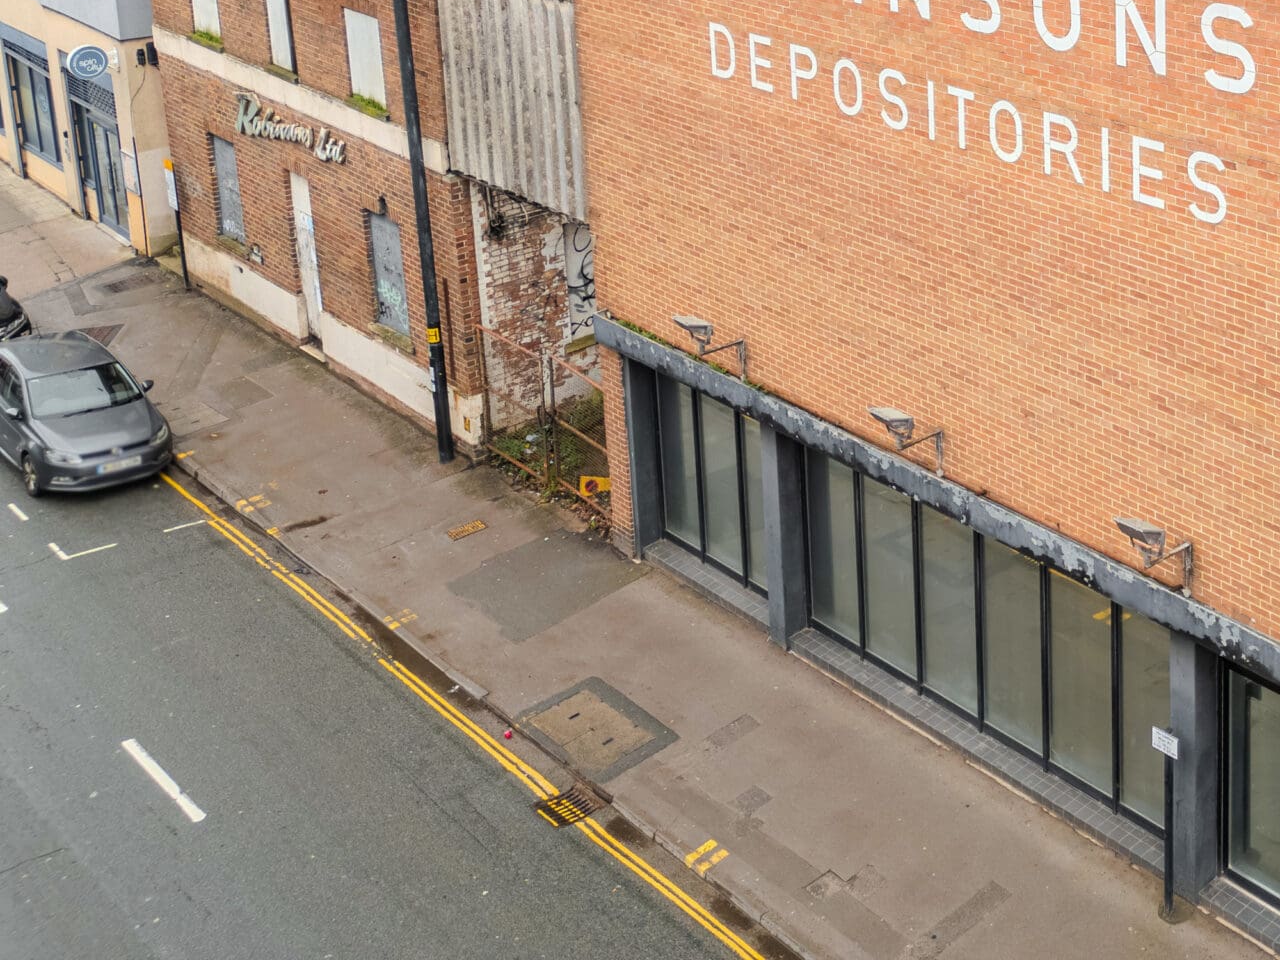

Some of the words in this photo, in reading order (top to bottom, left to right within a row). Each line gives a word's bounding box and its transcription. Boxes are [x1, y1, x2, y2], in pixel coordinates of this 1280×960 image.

[79, 57, 98, 67] spin
[86, 62, 103, 72] city
[708, 21, 1228, 225] DEPOSITORIES
